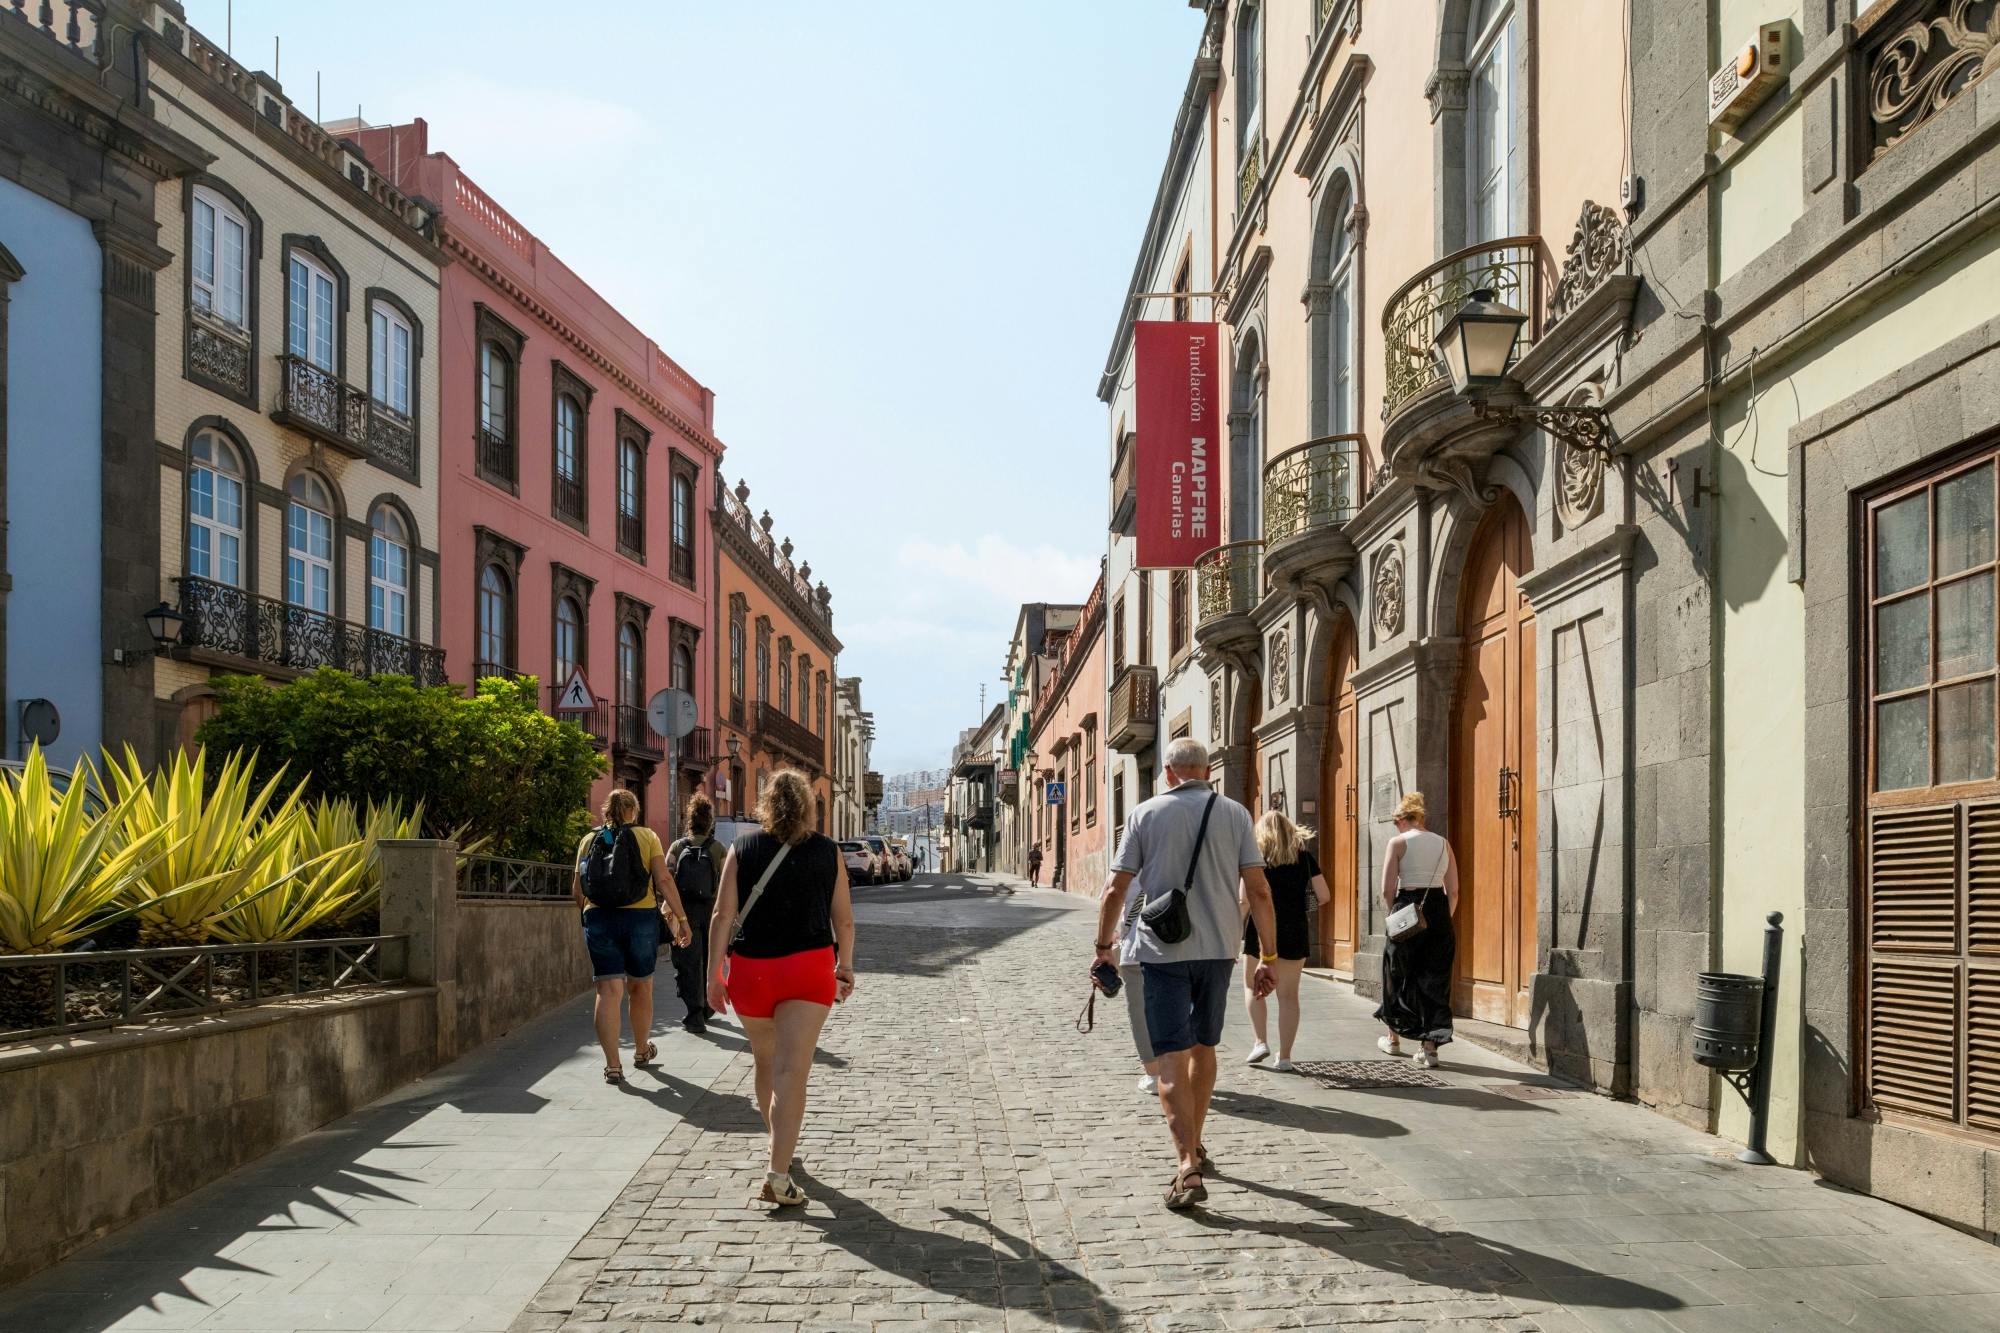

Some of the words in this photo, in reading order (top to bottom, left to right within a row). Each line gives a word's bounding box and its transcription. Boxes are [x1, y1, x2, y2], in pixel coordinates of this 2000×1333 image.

[1189, 335, 1206, 422] Fundación
[1171, 461, 1185, 538] Canarias
[1191, 437, 1207, 538] MAPFRE
